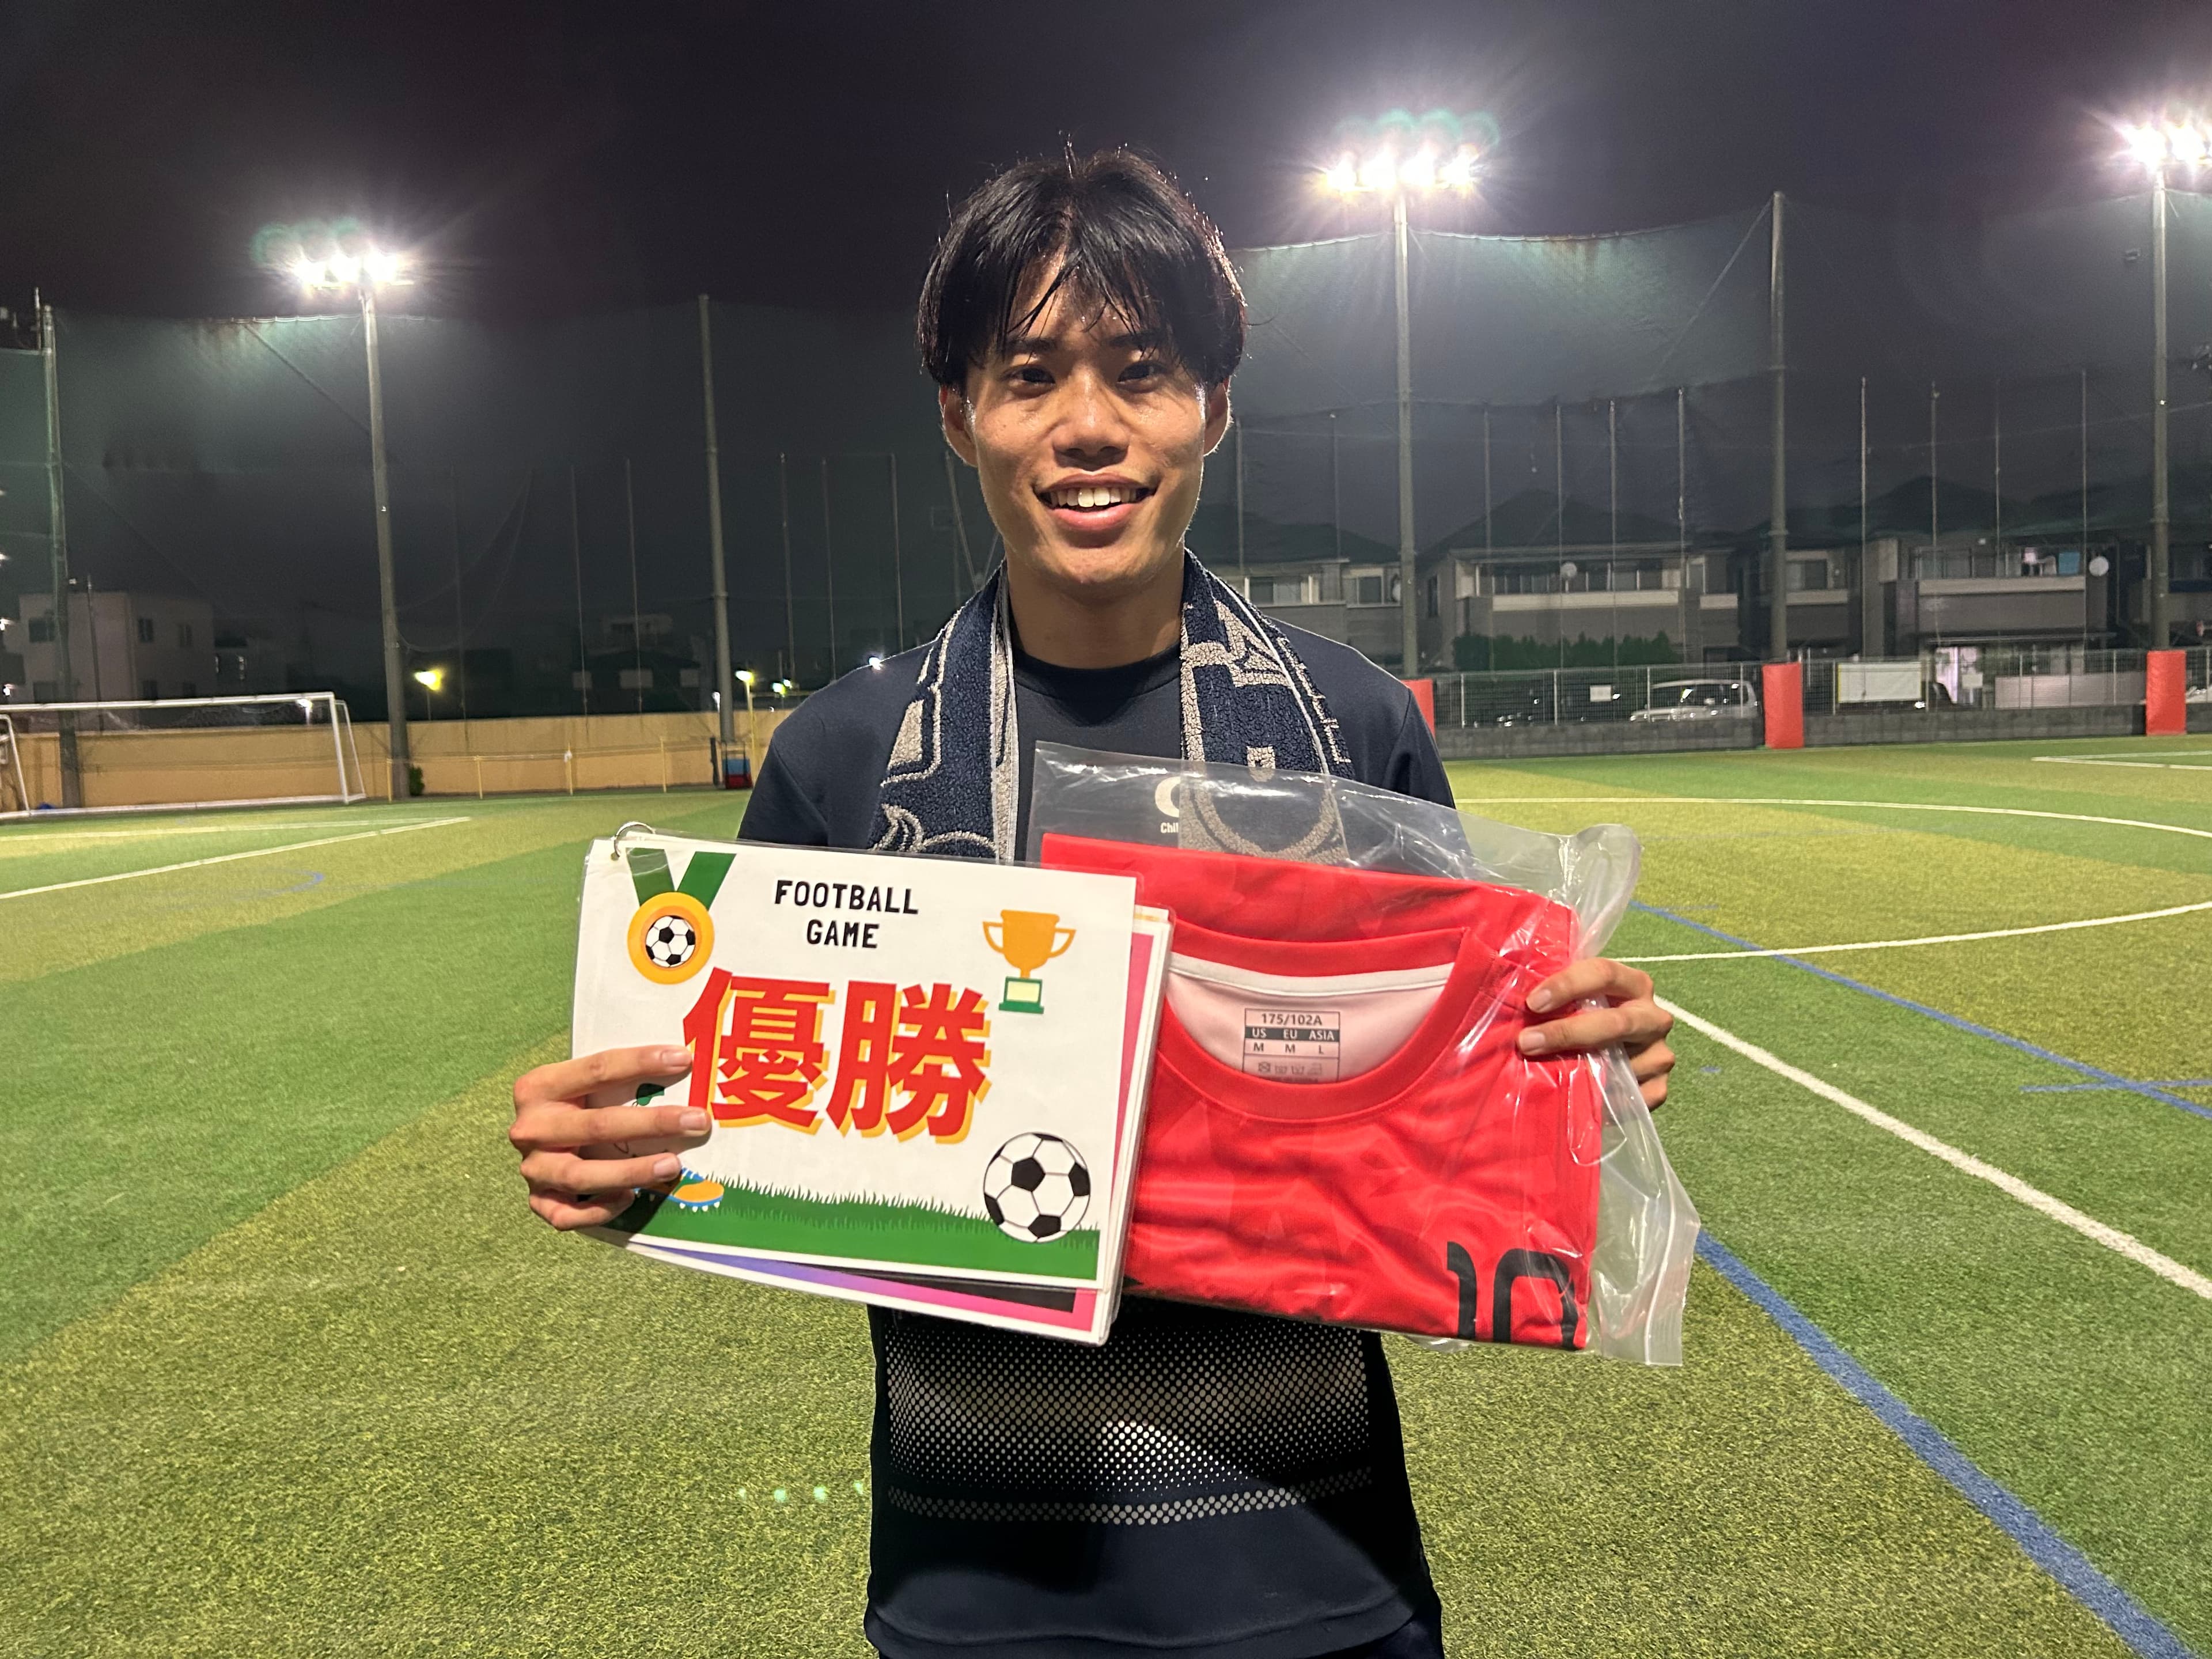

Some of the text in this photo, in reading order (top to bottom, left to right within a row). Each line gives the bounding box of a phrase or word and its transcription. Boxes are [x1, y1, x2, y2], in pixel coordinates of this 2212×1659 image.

[774, 880, 919, 915] FOOTBALL
[806, 919, 880, 949] GAME
[1261, 1013, 1323, 1027] 175/102A
[1251, 1027, 1335, 1041] US EU ASIA
[683, 967, 991, 1143] 優勝
[1253, 1042, 1324, 1055] M M L
